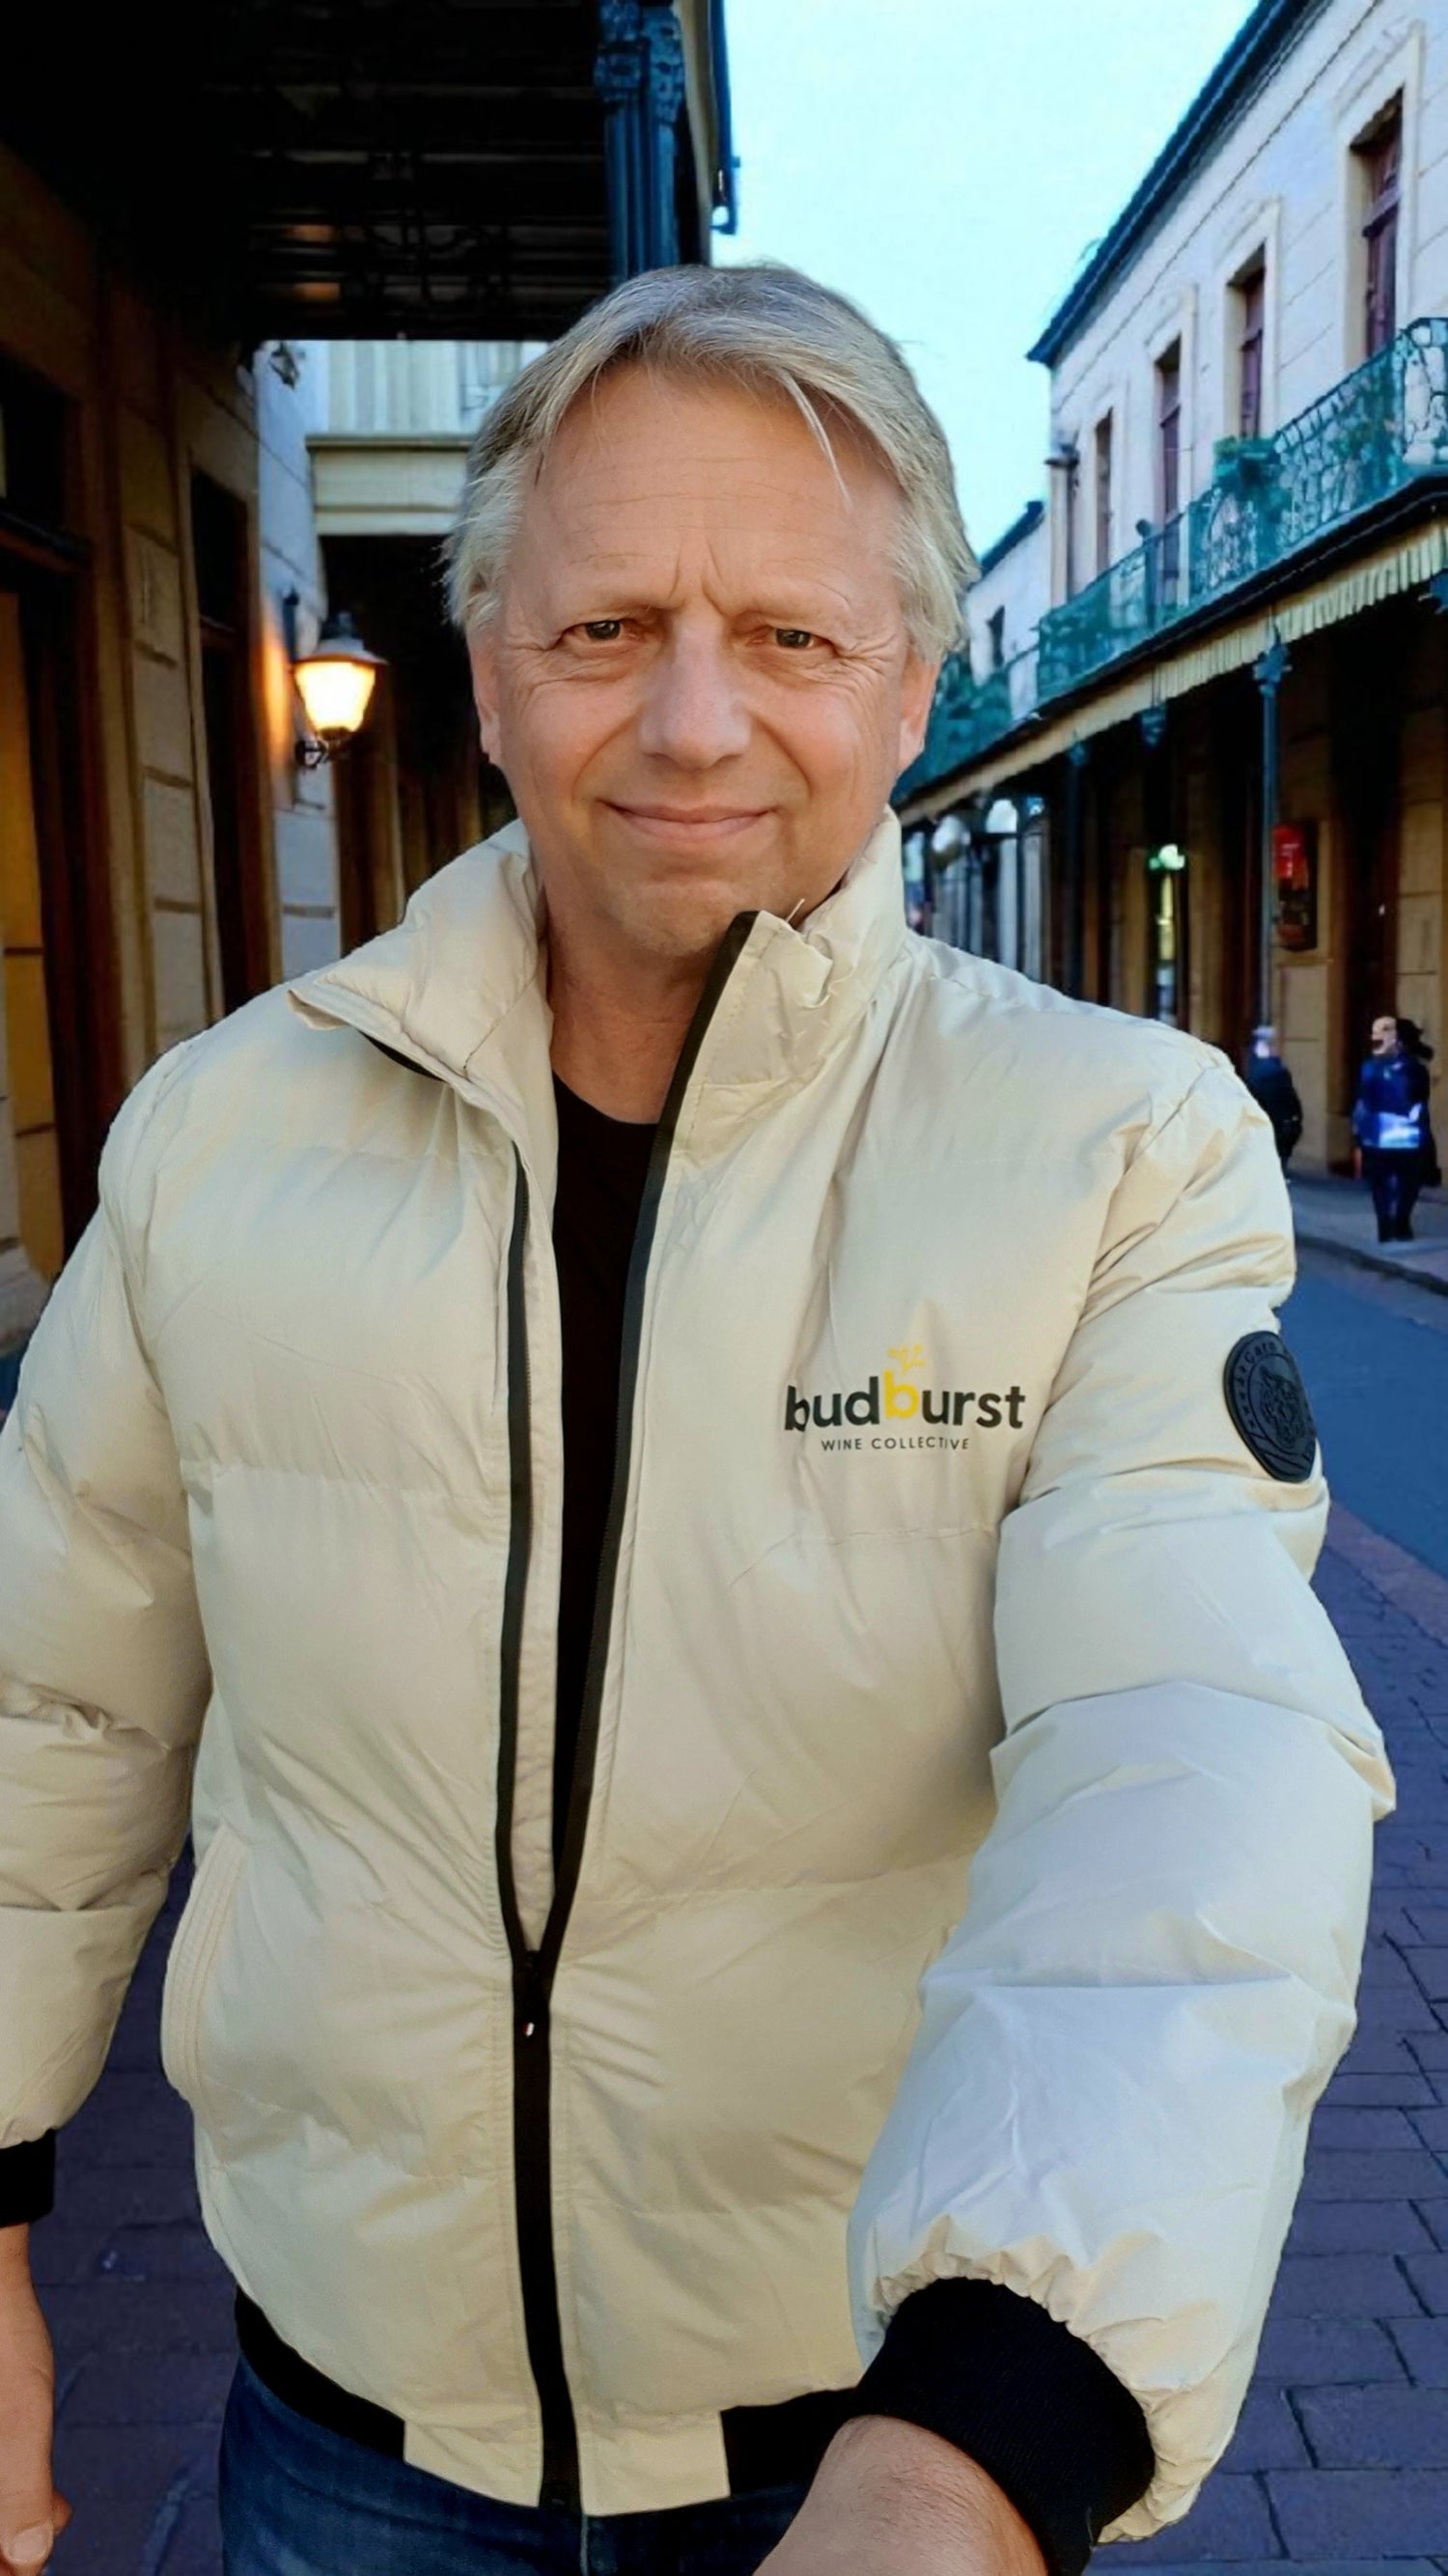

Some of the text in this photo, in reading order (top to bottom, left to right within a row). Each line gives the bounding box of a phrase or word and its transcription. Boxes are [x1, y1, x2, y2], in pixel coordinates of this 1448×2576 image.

[785, 1370, 1025, 1431] budburst
[821, 1437, 970, 1451] WINE COLLECTIVE
